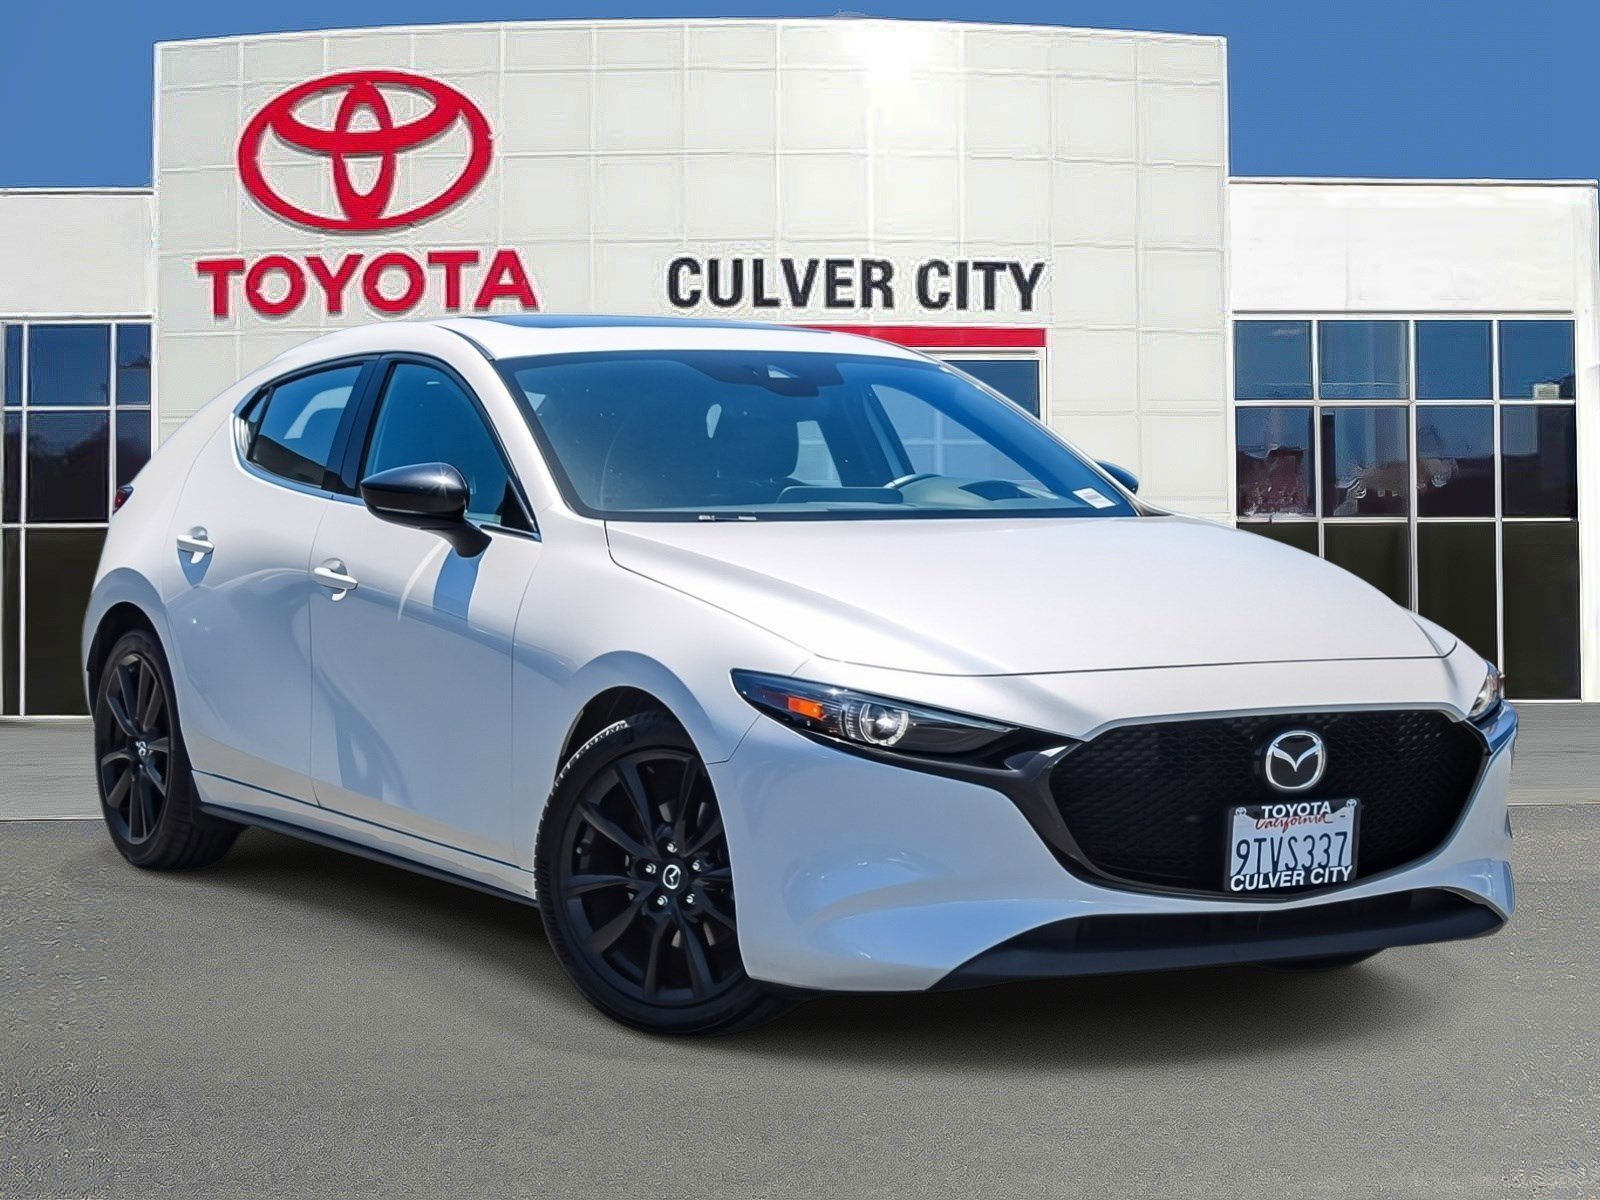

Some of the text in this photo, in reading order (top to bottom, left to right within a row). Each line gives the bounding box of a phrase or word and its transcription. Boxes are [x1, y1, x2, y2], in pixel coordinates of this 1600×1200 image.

[195, 249, 540, 319] TOYOTA
[667, 256, 1046, 311] CULVER CITY
[1261, 801, 1332, 819] TOYOTA
[1235, 832, 1348, 875] 9TVS337
[1230, 865, 1353, 892] CULVER CITY
